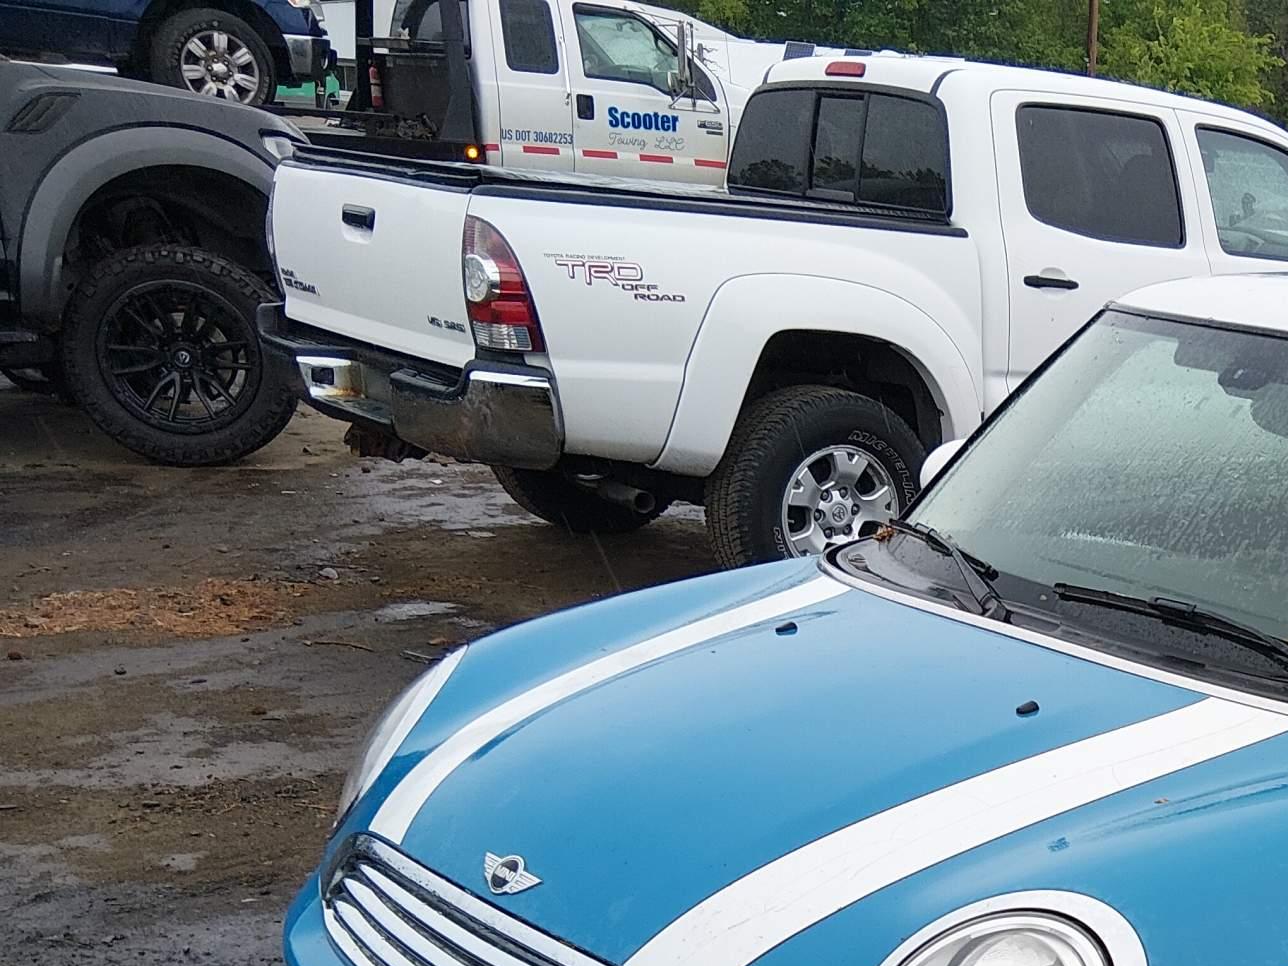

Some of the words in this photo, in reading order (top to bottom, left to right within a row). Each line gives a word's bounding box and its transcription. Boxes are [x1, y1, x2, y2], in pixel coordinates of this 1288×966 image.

[607, 106, 679, 132] Scooter
[501, 128, 513, 140] US
[515, 129, 532, 142] DOT
[608, 132, 648, 150] Towing
[654, 136, 685, 150] LLC
[555, 260, 643, 286] TRD
[621, 283, 659, 292] OFF
[634, 293, 685, 302] ROAD
[495, 864, 517, 882] MINI
